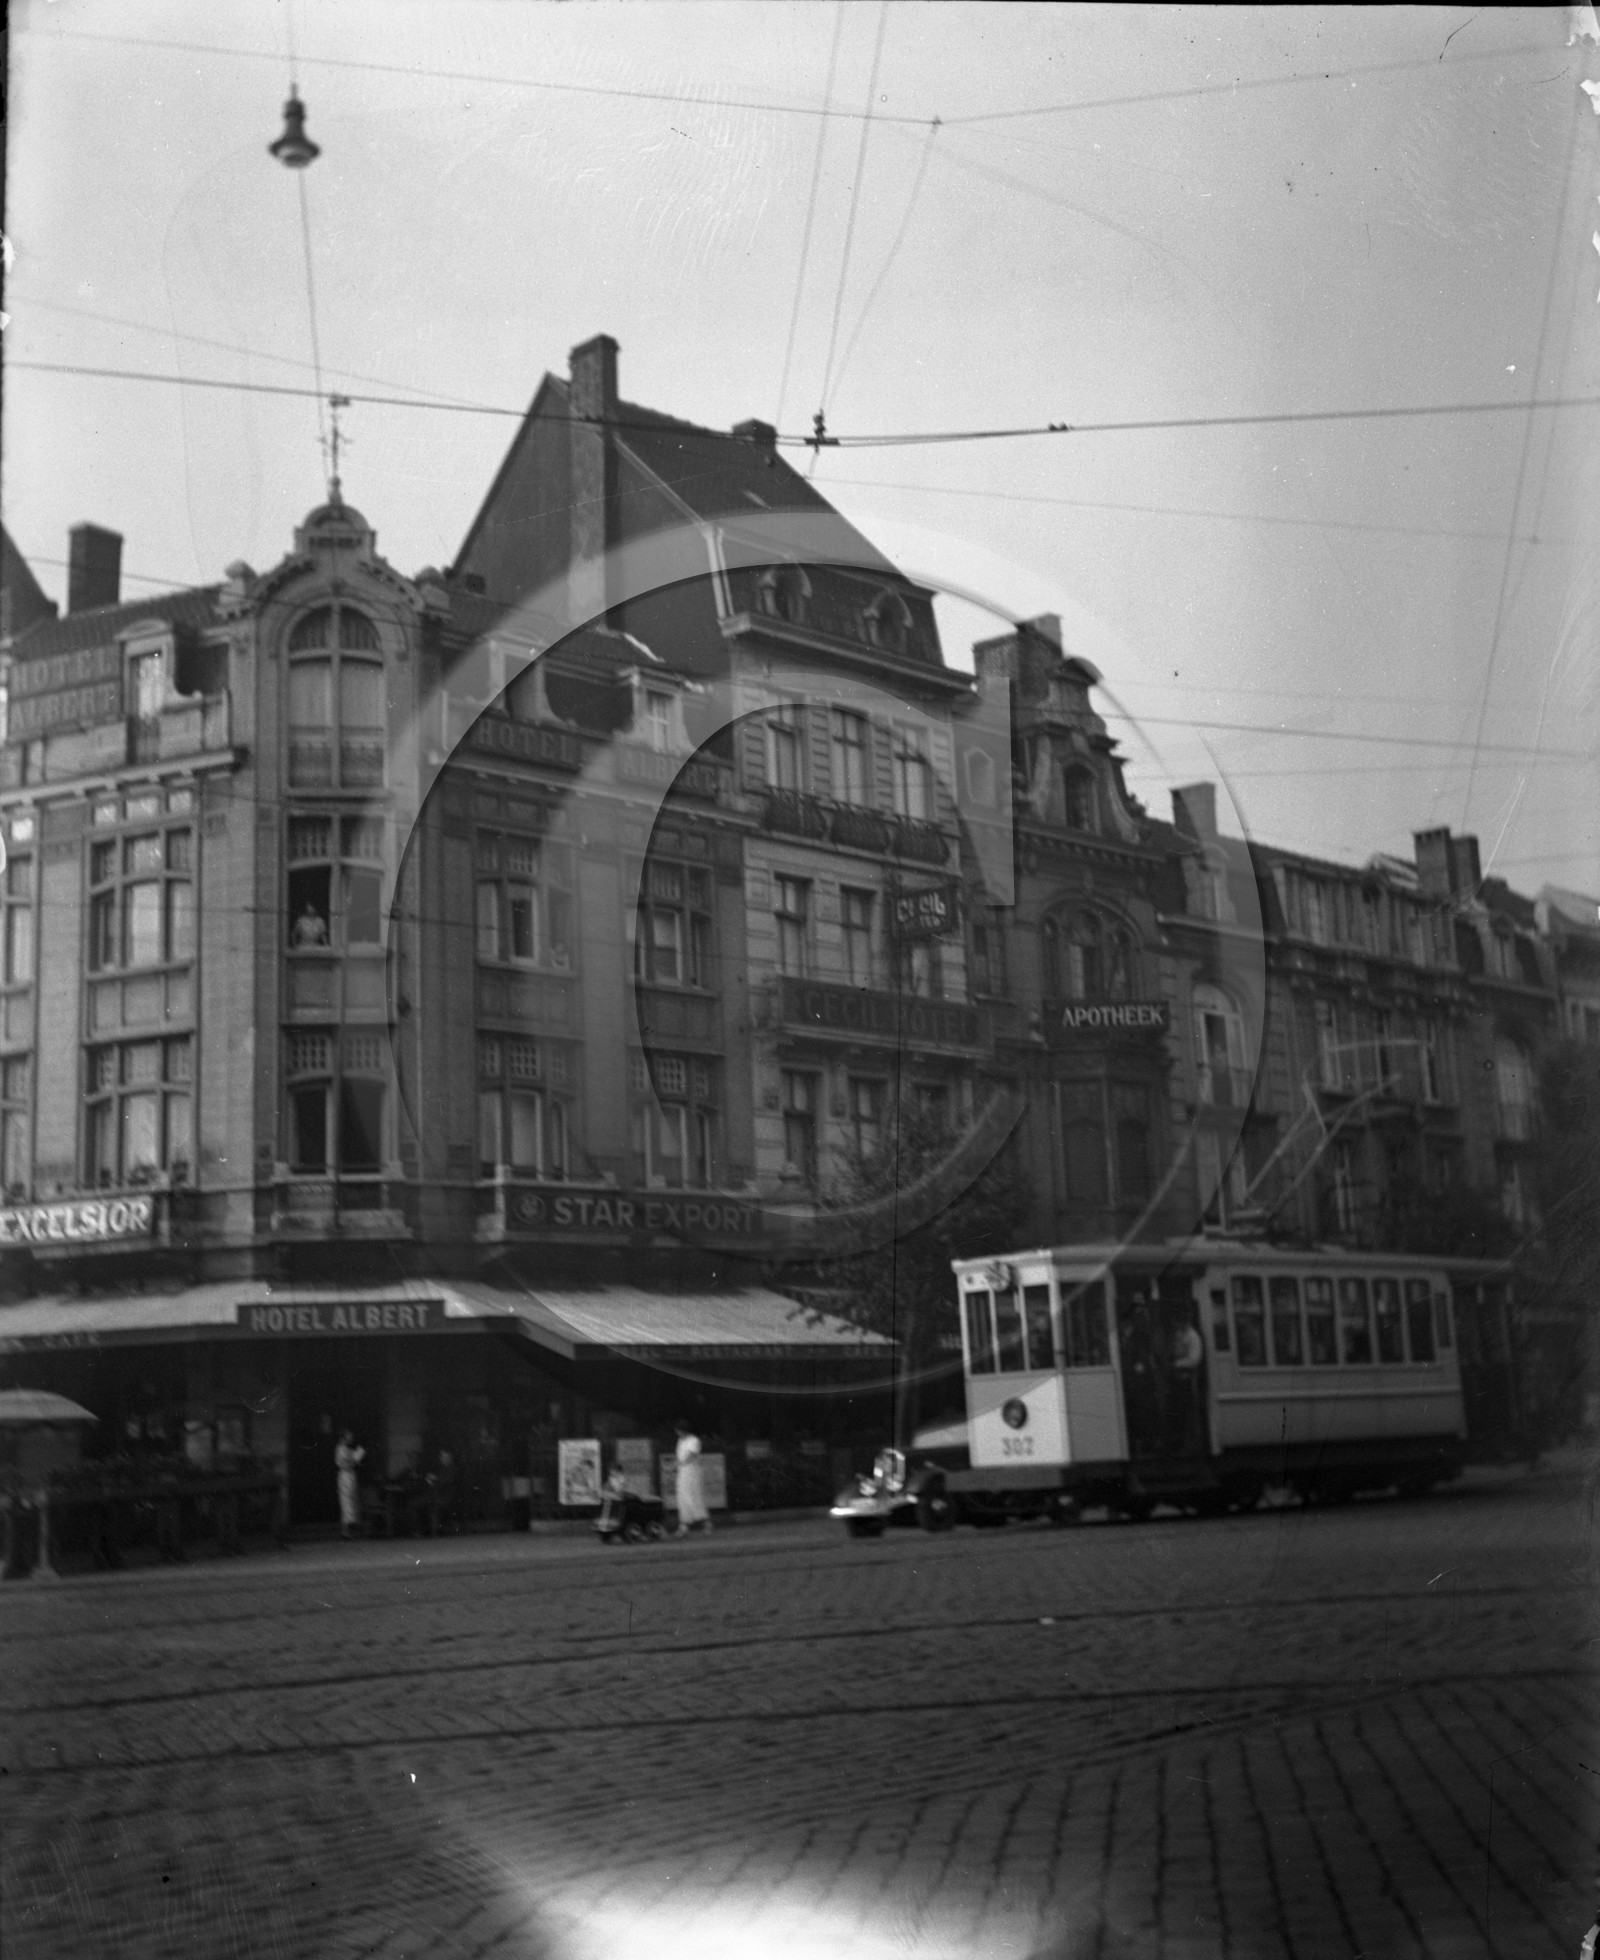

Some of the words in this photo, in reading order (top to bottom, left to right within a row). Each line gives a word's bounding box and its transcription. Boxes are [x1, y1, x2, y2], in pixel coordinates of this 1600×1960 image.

[10, 648, 113, 694] HOTEL
[10, 682, 115, 732] ALBERT
[478, 718, 572, 763] HOTEL
[804, 990, 886, 1033] CECIL
[893, 1002, 977, 1042] HOTEL
[1062, 1004, 1164, 1028] APOTHEEK
[0, 1196, 149, 1242] EXCELSIOR
[552, 1196, 635, 1229] STAR
[643, 1202, 755, 1234] EXPORT
[250, 1305, 326, 1333] HOTEL
[331, 1303, 429, 1331] ALBERT
